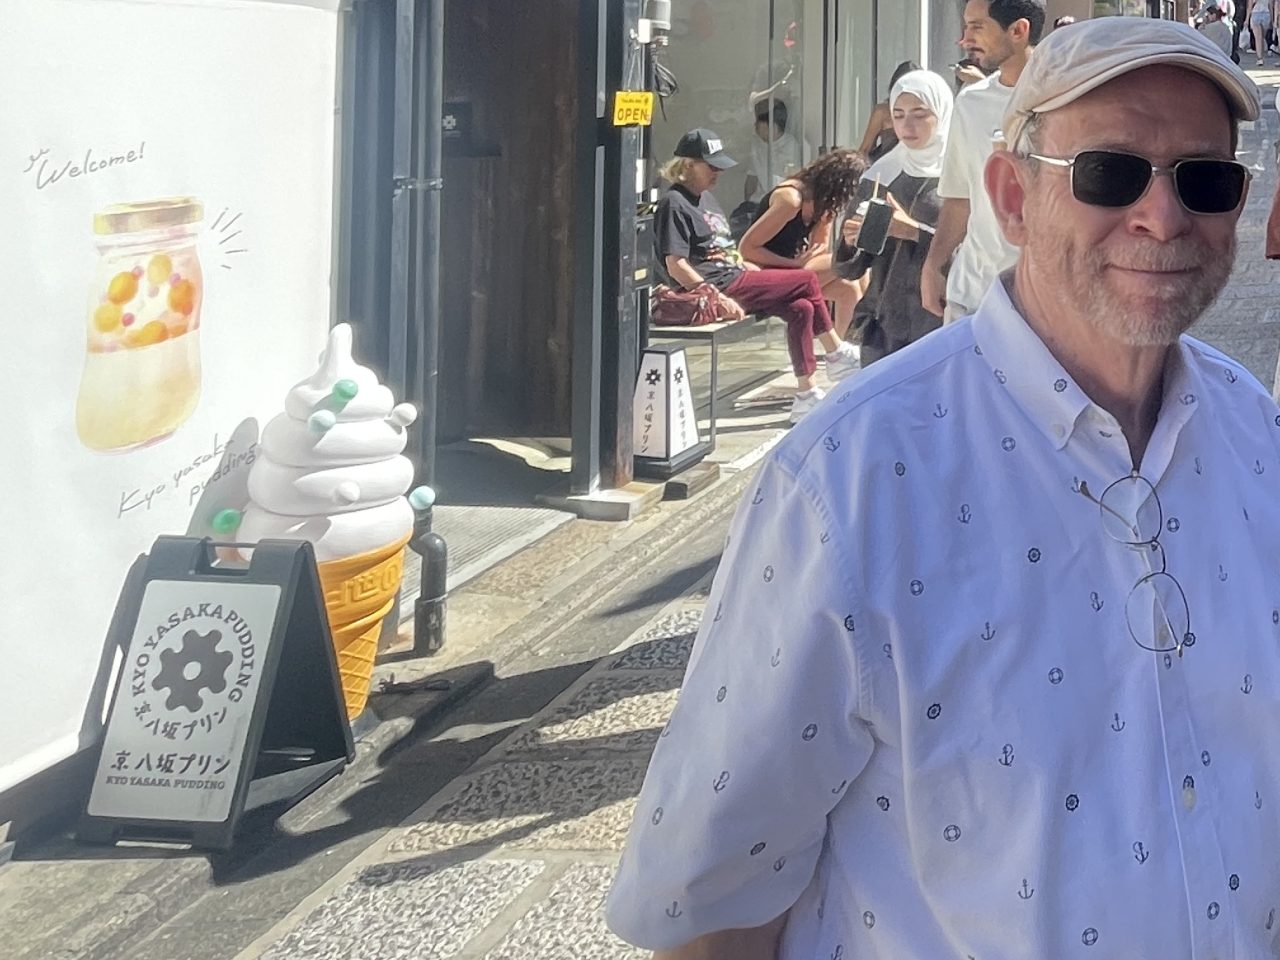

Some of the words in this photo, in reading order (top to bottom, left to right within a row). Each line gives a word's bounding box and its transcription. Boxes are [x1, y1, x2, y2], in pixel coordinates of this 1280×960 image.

[617, 108, 648, 121] OPEN
[36, 141, 146, 189] Welcome!
[189, 442, 257, 506] pudding
[117, 489, 167, 519] Kyo
[132, 653, 150, 697] KYO
[144, 603, 223, 650] YASAKA
[223, 609, 255, 703] PUDDING
[110, 750, 231, 775] 京八坂プリン
[106, 776, 128, 785] KYO
[129, 776, 171, 788] YASAKA
[173, 779, 225, 790] PUDDING
